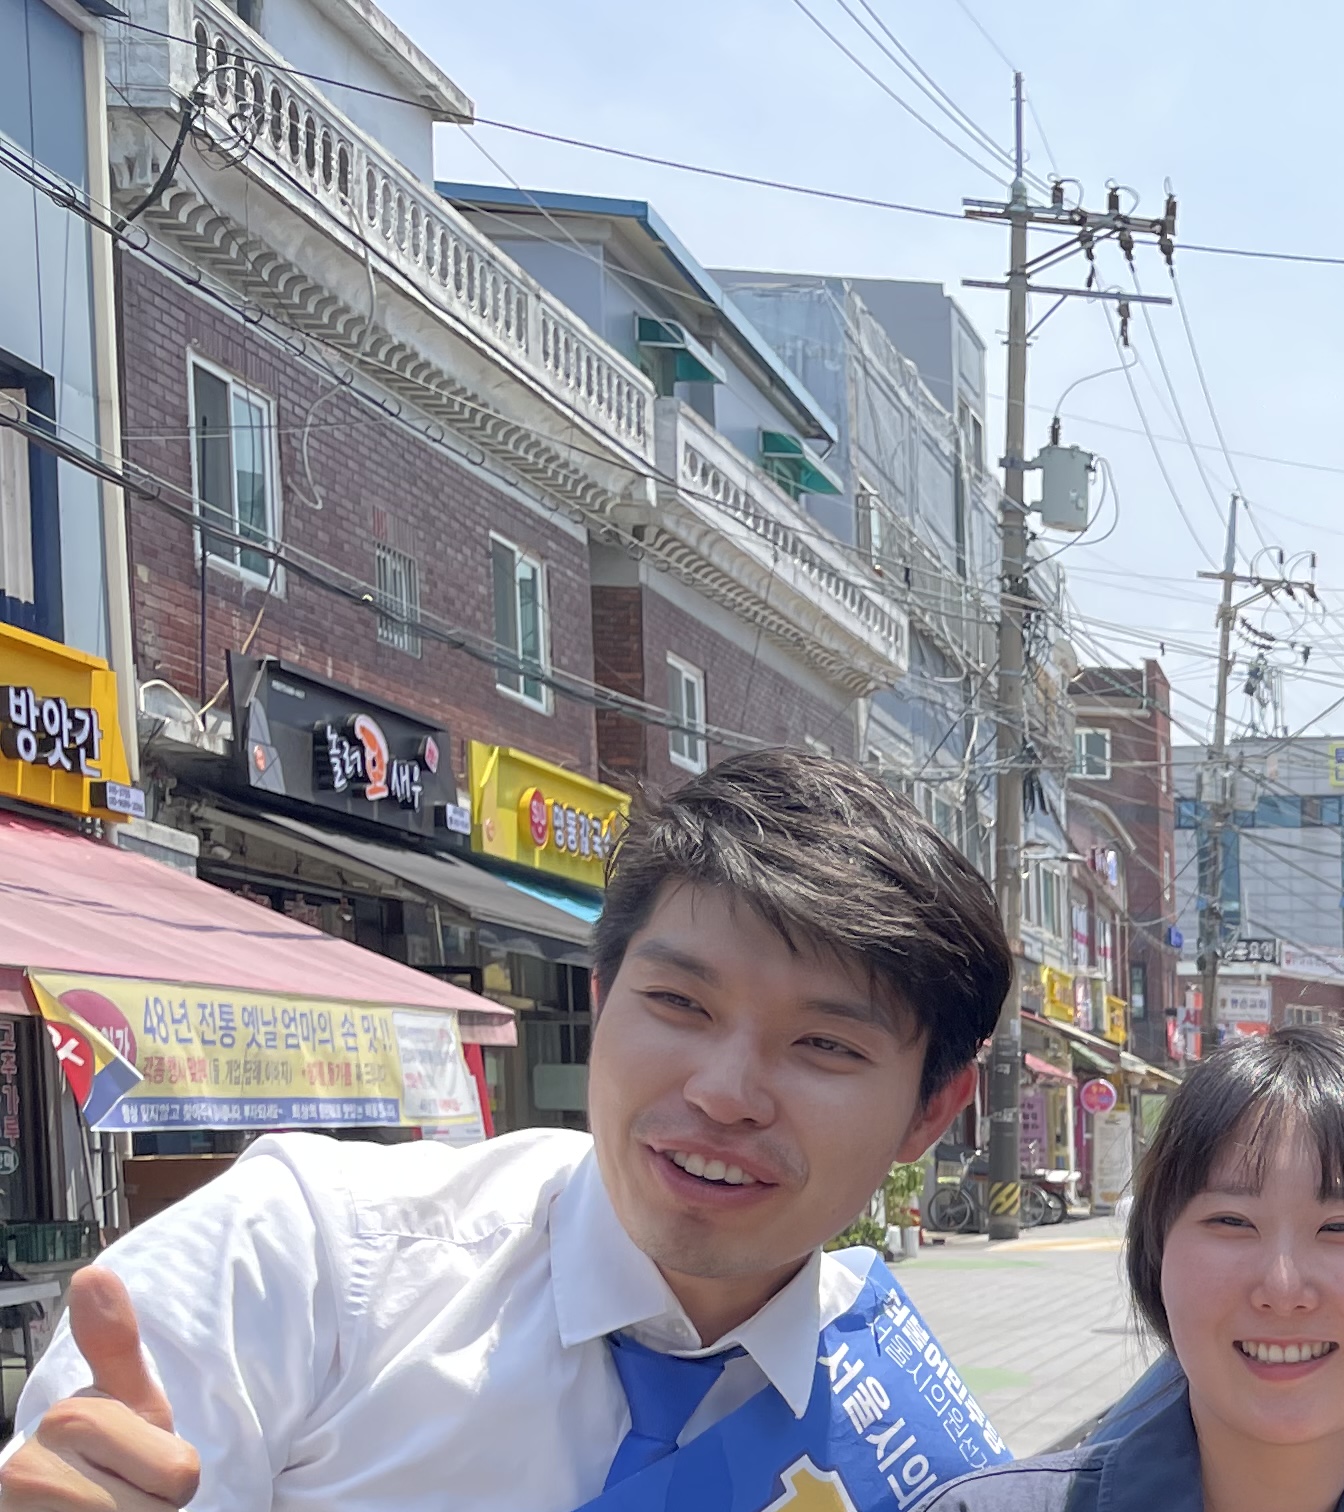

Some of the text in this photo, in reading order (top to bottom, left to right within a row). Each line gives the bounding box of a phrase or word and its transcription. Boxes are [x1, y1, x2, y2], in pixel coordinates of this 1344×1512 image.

[9, 686, 102, 777] 방앗간
[143, 996, 193, 1046] 48년
[197, 1001, 237, 1049] 전통
[818, 1342, 938, 1511] 서울시의
